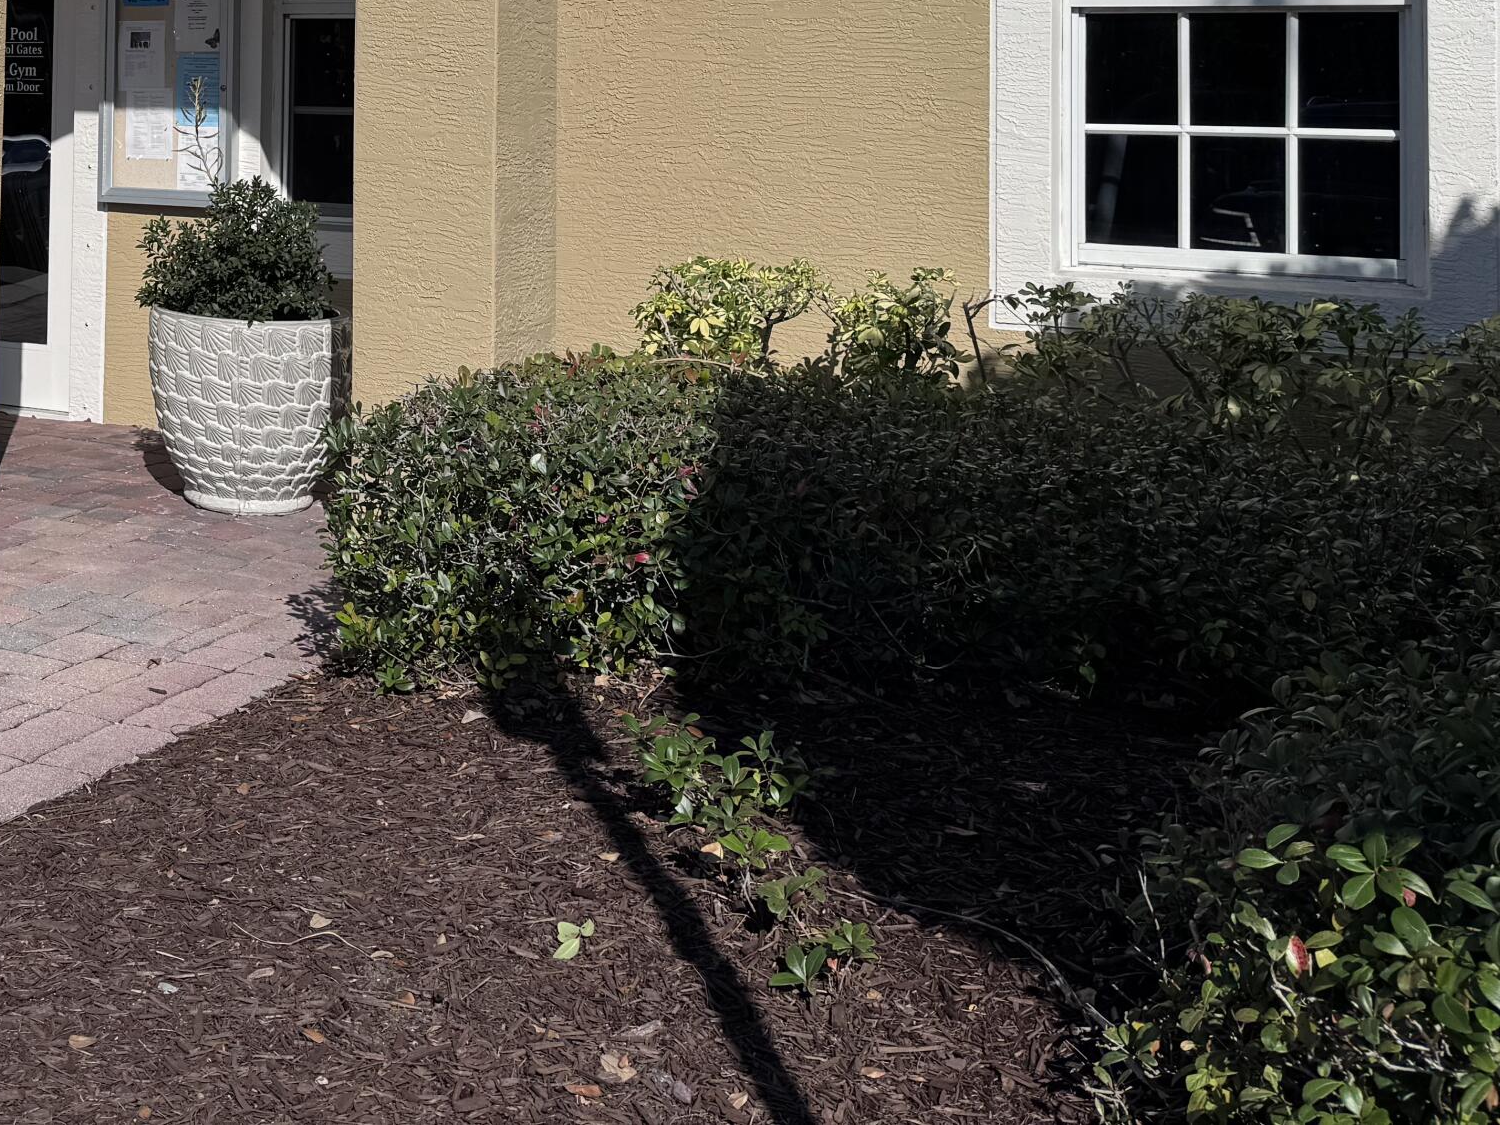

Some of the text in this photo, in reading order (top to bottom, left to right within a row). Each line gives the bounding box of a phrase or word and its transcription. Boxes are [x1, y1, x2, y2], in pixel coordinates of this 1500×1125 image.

[10, 27, 38, 41] Pool
[5, 44, 42, 55] ol Gates
[9, 62, 37, 80] Gym
[16, 81, 40, 92] Door
